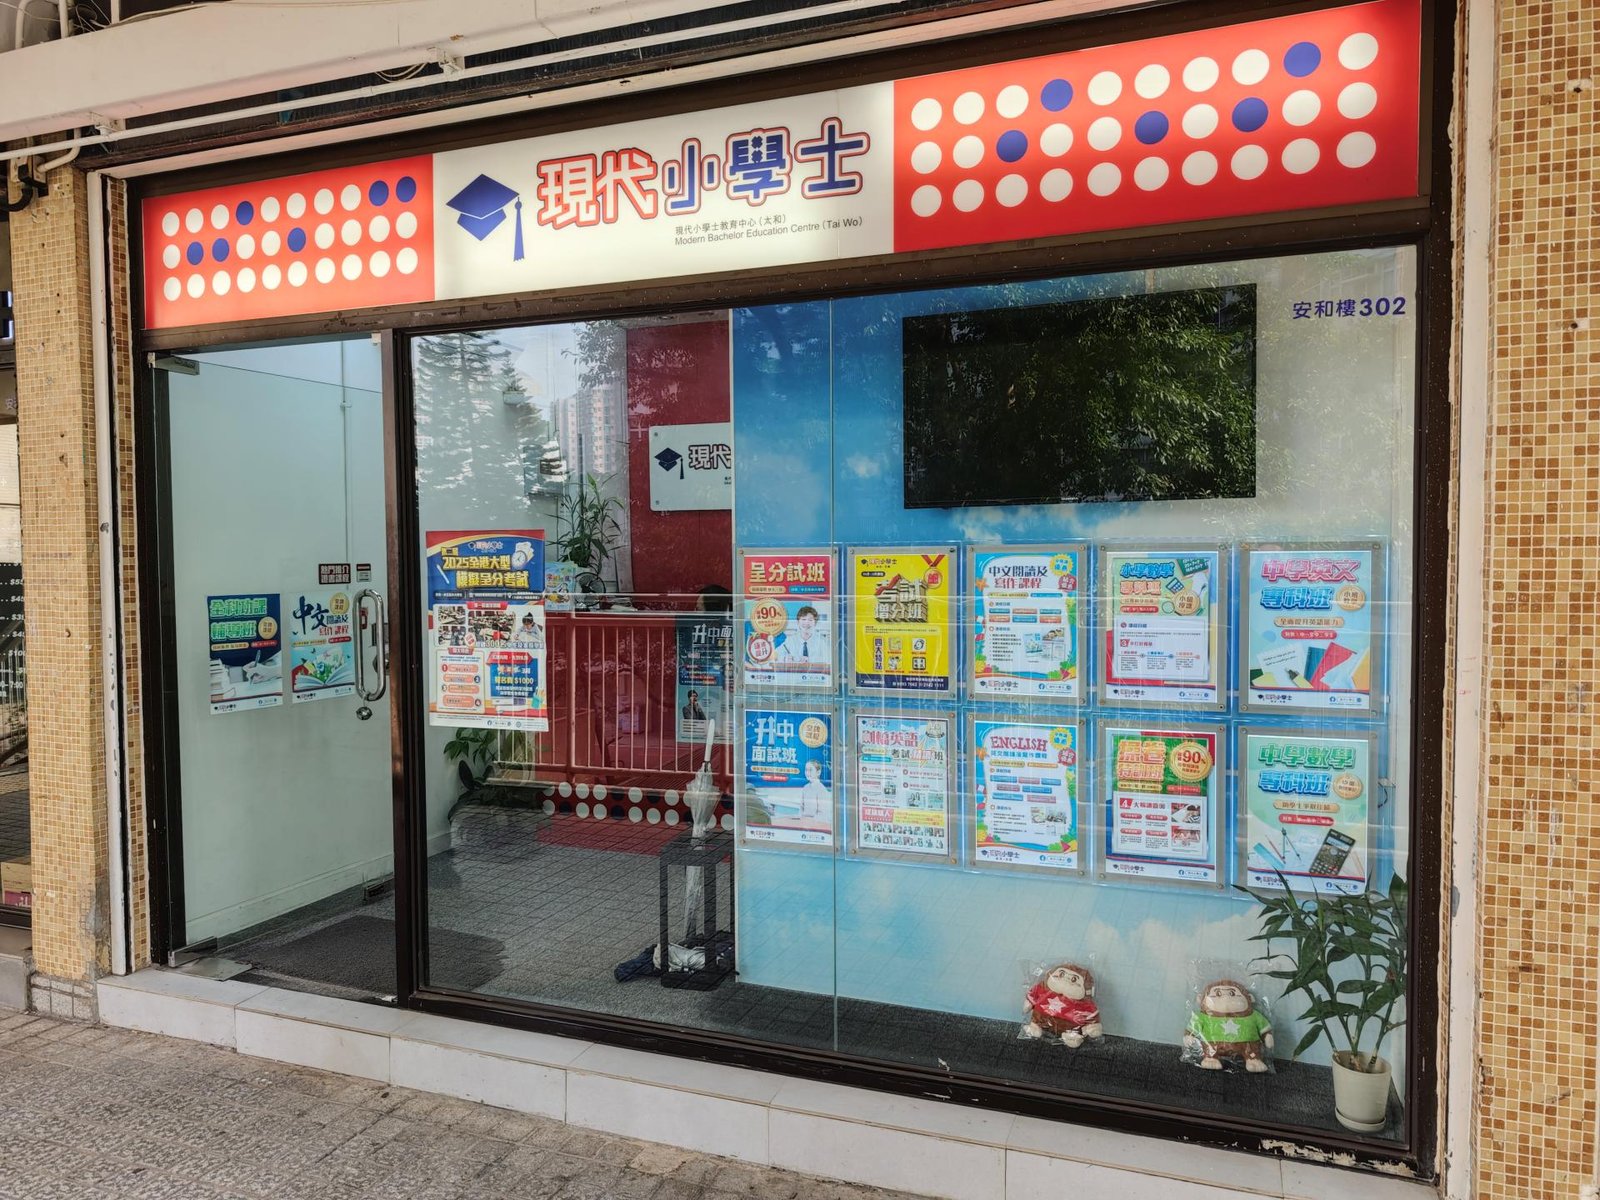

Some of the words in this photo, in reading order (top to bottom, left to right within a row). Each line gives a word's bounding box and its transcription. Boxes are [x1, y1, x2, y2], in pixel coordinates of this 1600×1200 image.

[537, 117, 870, 230] 現代小學士
[675, 235, 706, 246] Modern
[707, 231, 744, 242] Bachelor
[746, 227, 789, 238] Education
[790, 223, 820, 233] Centre
[822, 219, 841, 230] (Tai
[843, 216, 863, 227] Wo)
[1292, 297, 1406, 319] 安和樓302
[749, 562, 826, 583] 呈分試班
[989, 565, 1048, 577] 中文閱讀及
[1261, 558, 1360, 583] 中學英文
[293, 595, 329, 635] 中文
[692, 623, 733, 644] 升中面
[754, 715, 794, 745] 升中
[751, 745, 798, 765] 面試班
[990, 736, 1048, 752] ENGLISH
[1259, 743, 1355, 769] 中學數學
